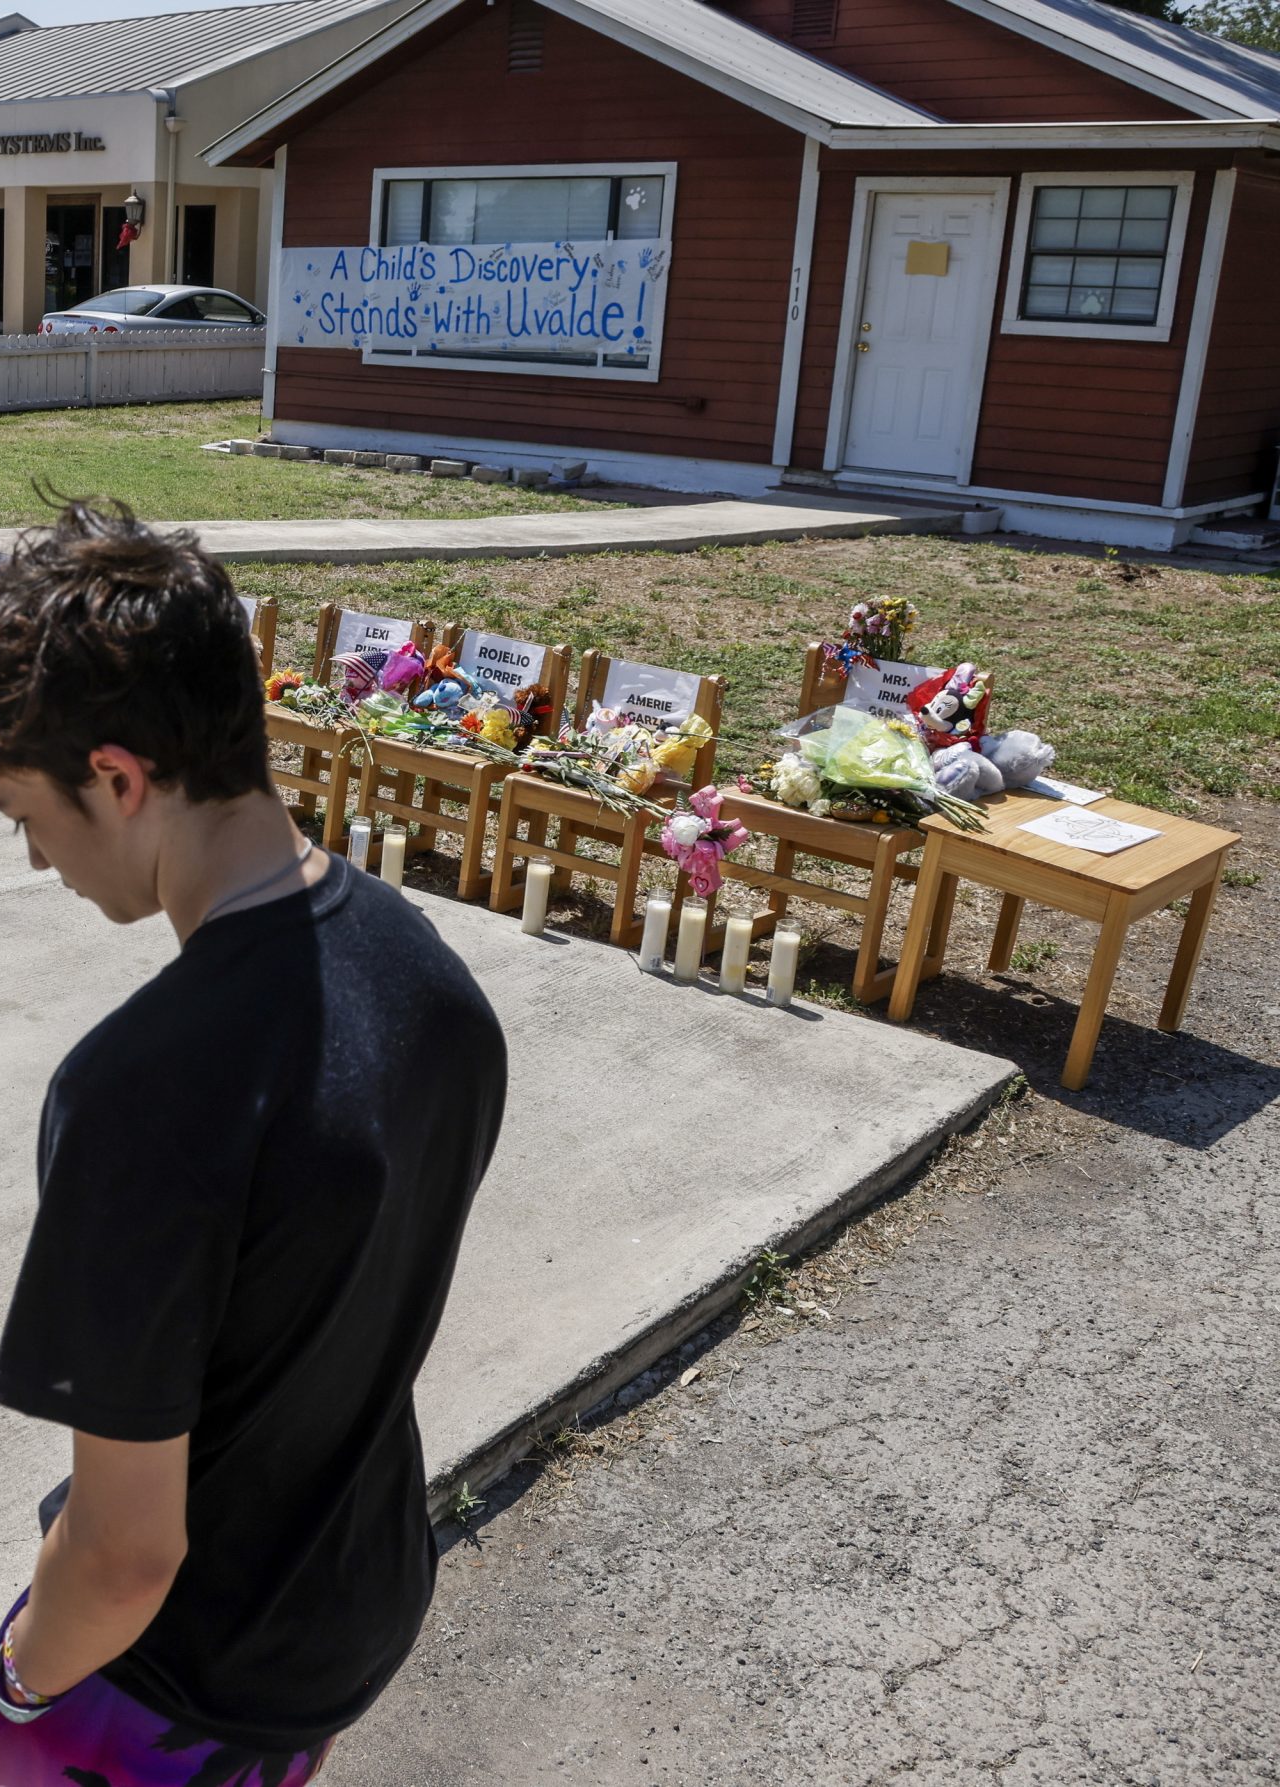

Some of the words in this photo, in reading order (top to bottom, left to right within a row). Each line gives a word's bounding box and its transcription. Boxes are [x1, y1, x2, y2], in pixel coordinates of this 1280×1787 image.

[73, 131, 106, 152] Inc.
[330, 249, 348, 281] A
[359, 246, 436, 283] Child's
[791, 267, 801, 321] 710
[318, 291, 418, 338] Stands
[433, 294, 492, 336] With
[365, 626, 390, 641] LEXI
[478, 646, 530, 668] ROJELIO
[476, 665, 522, 687] TORRES
[882, 673, 911, 688] MRS.
[626, 693, 673, 713] AMERIE
[877, 689, 908, 704] IRMA
[627, 711, 666, 727] GARZA
